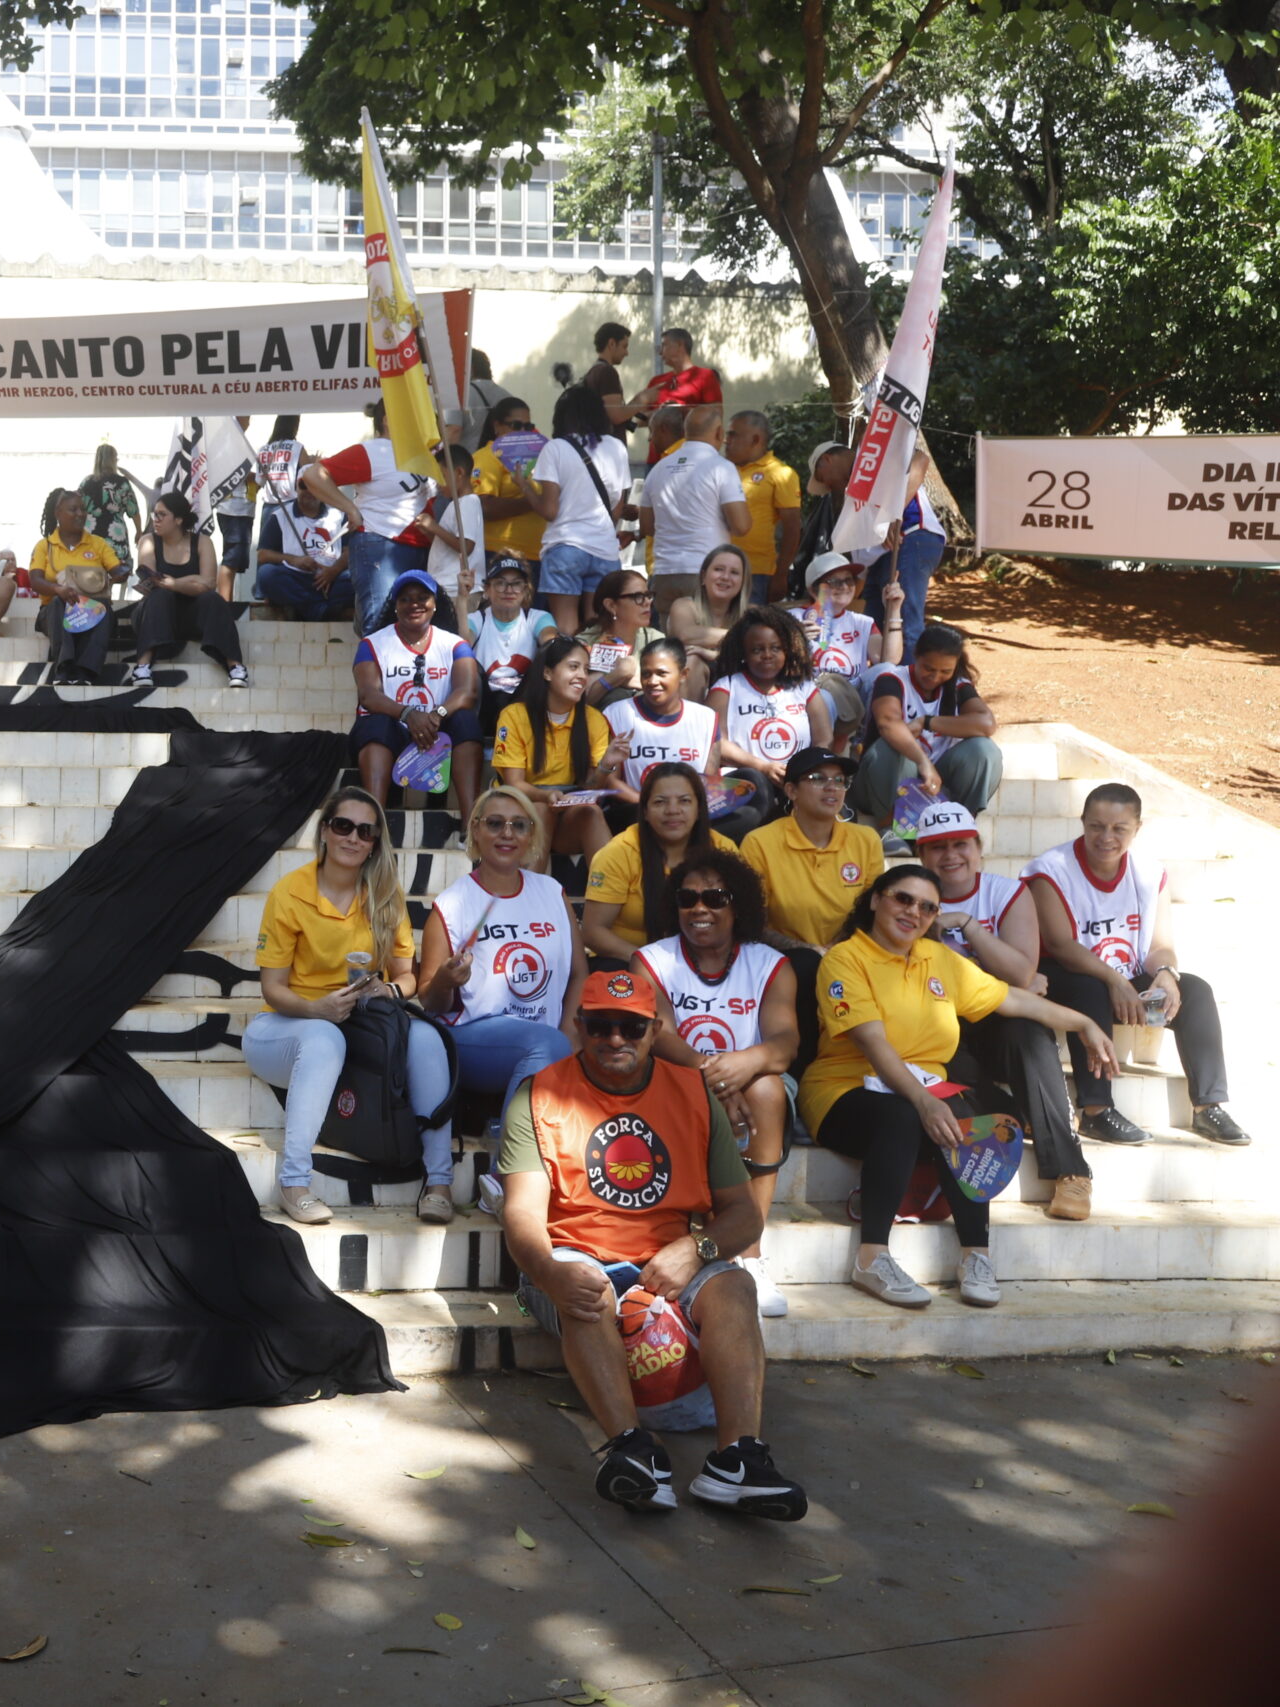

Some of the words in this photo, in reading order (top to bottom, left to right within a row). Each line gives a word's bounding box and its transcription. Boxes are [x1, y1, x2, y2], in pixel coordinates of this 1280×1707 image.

[161, 327, 294, 376] PELA
[24, 386, 79, 399] HERZOG,
[82, 385, 135, 397] CENTRO
[139, 383, 208, 396] CULTURAL
[212, 383, 221, 394] A
[225, 380, 251, 394] CÉU
[256, 379, 309, 393] ABERTO
[313, 377, 359, 391] ELIFAS
[1202, 463, 1256, 483] DIA
[1027, 470, 1091, 510] 28
[1167, 492, 1225, 512] DAS
[1233, 486, 1280, 512] VÍT
[1020, 513, 1094, 530] ABRIL
[1228, 521, 1280, 541] REL
[765, 741, 790, 750] UGT
[924, 813, 964, 828] UGT
[512, 972, 538, 983] UGT
[594, 1117, 654, 1147] FORÇA
[970, 1152, 980, 1161] E
[960, 1159, 976, 1184] CUIDE
[970, 1147, 995, 1189] BRINQUE
[588, 1166, 669, 1207] SINDICAL
